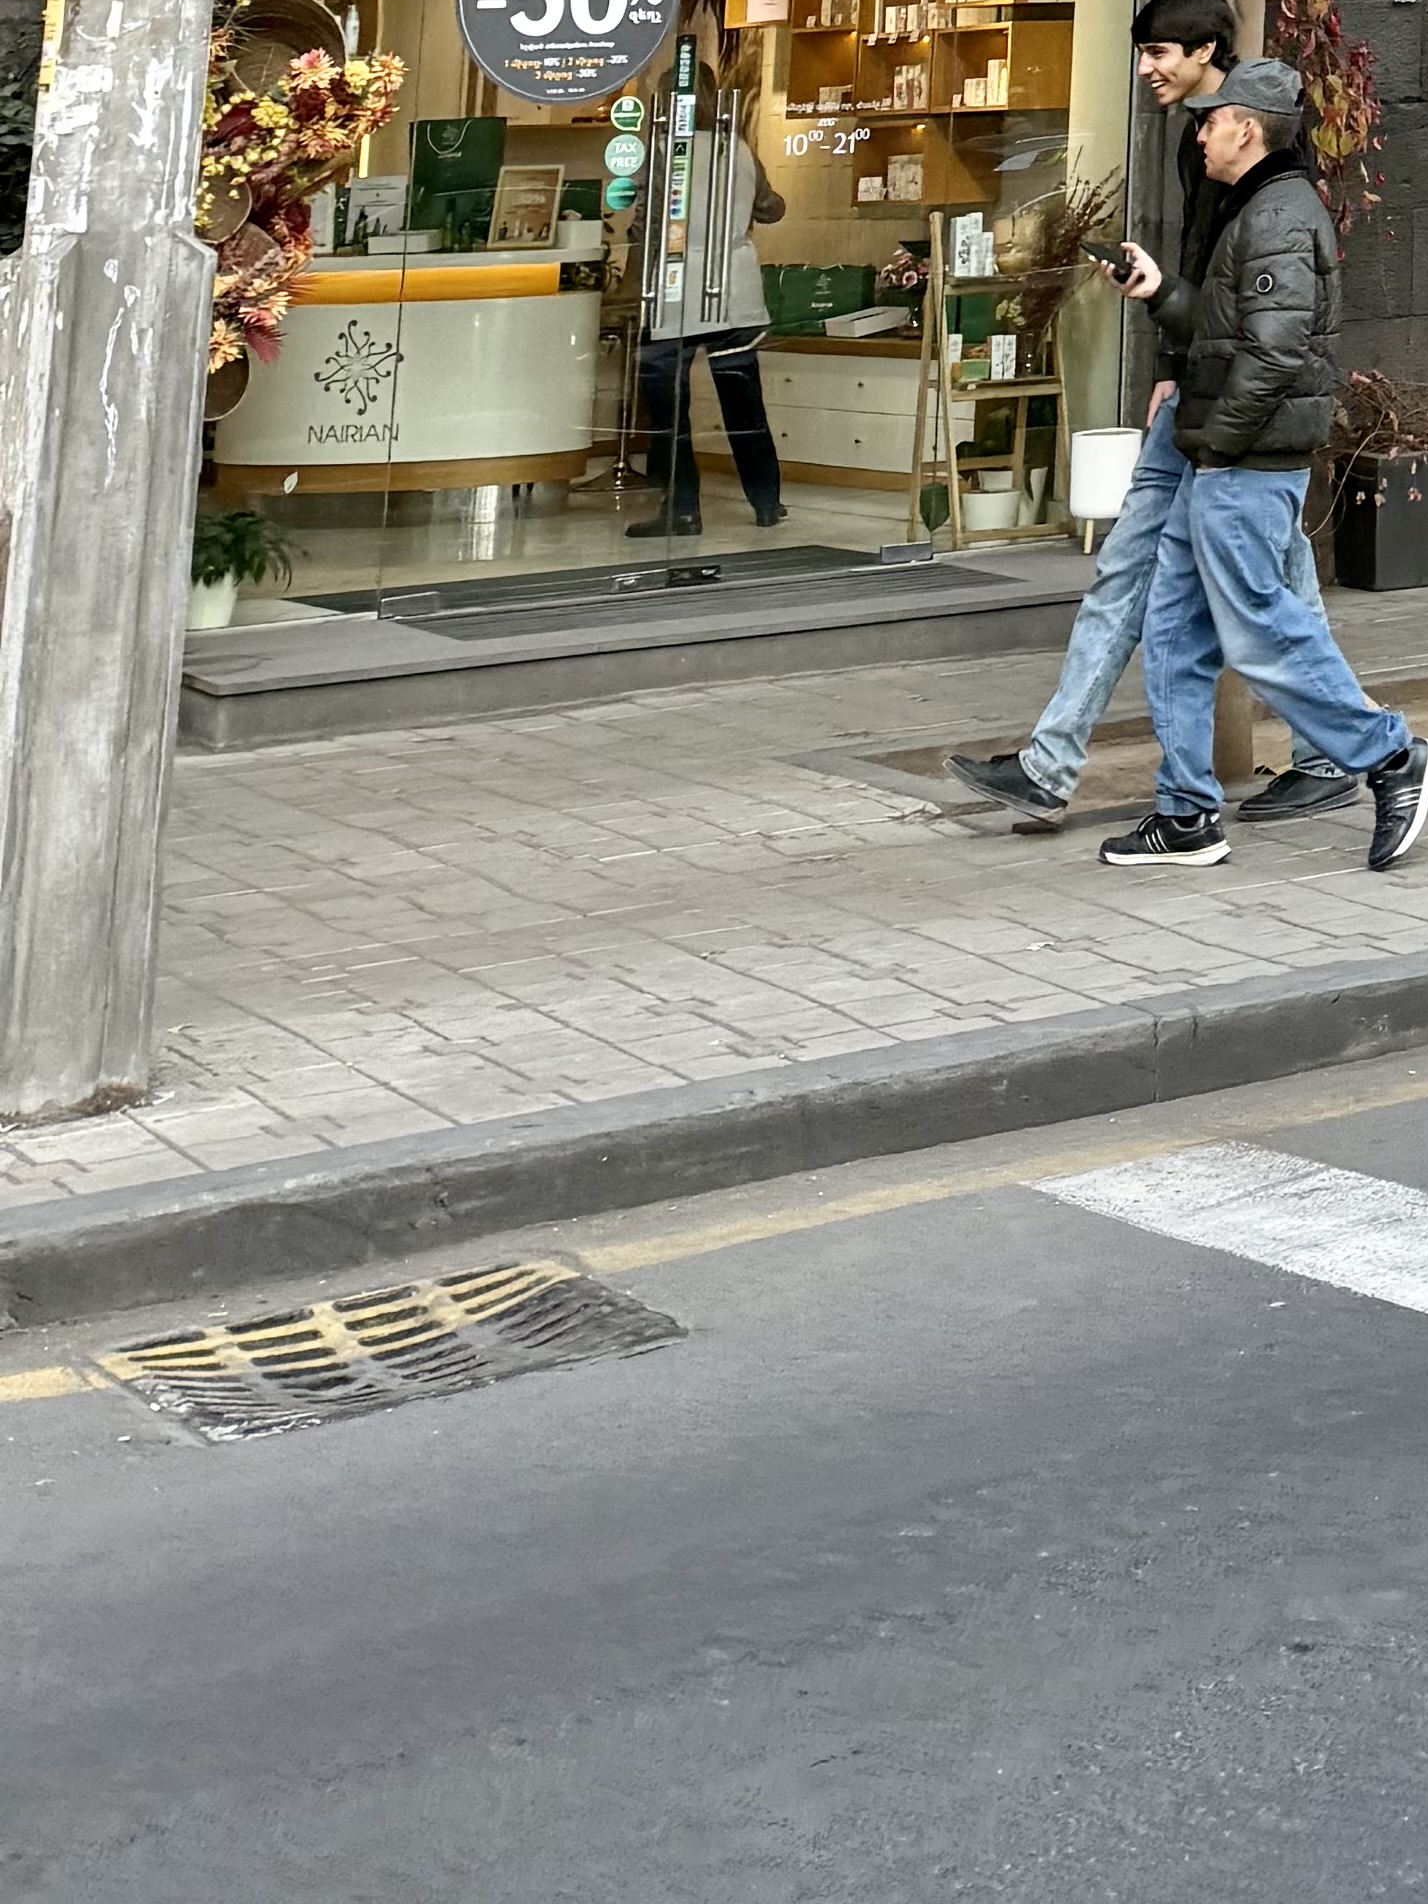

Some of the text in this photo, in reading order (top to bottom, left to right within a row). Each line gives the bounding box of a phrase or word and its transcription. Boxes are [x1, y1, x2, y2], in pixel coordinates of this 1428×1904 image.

[614, 141, 637, 154] TAX
[610, 155, 639, 169] FREE
[308, 423, 399, 445] NAIRIAN
